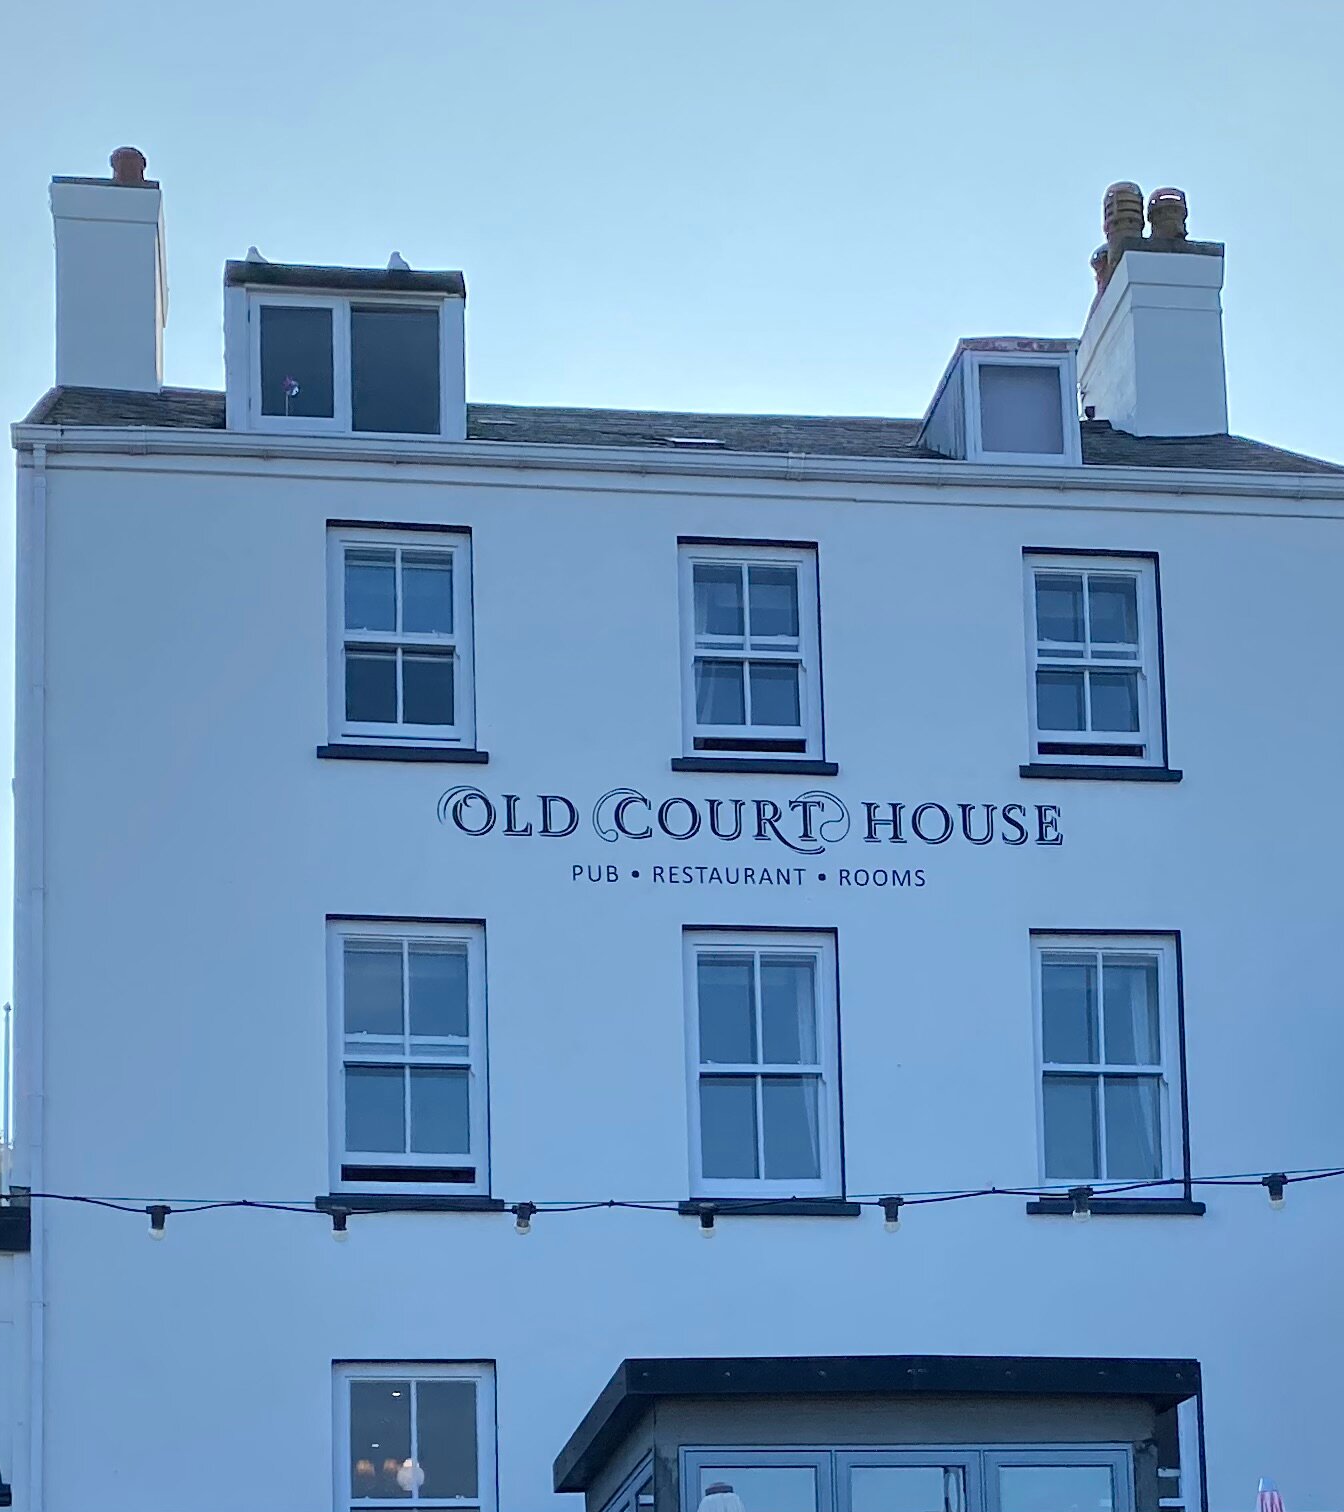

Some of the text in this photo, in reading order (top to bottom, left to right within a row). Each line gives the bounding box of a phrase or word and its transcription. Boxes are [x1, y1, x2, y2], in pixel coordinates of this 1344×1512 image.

[437, 785, 1064, 854] OLD COURT HOUSE
[572, 864, 927, 887] PUB RESTAURANT ROOMS
